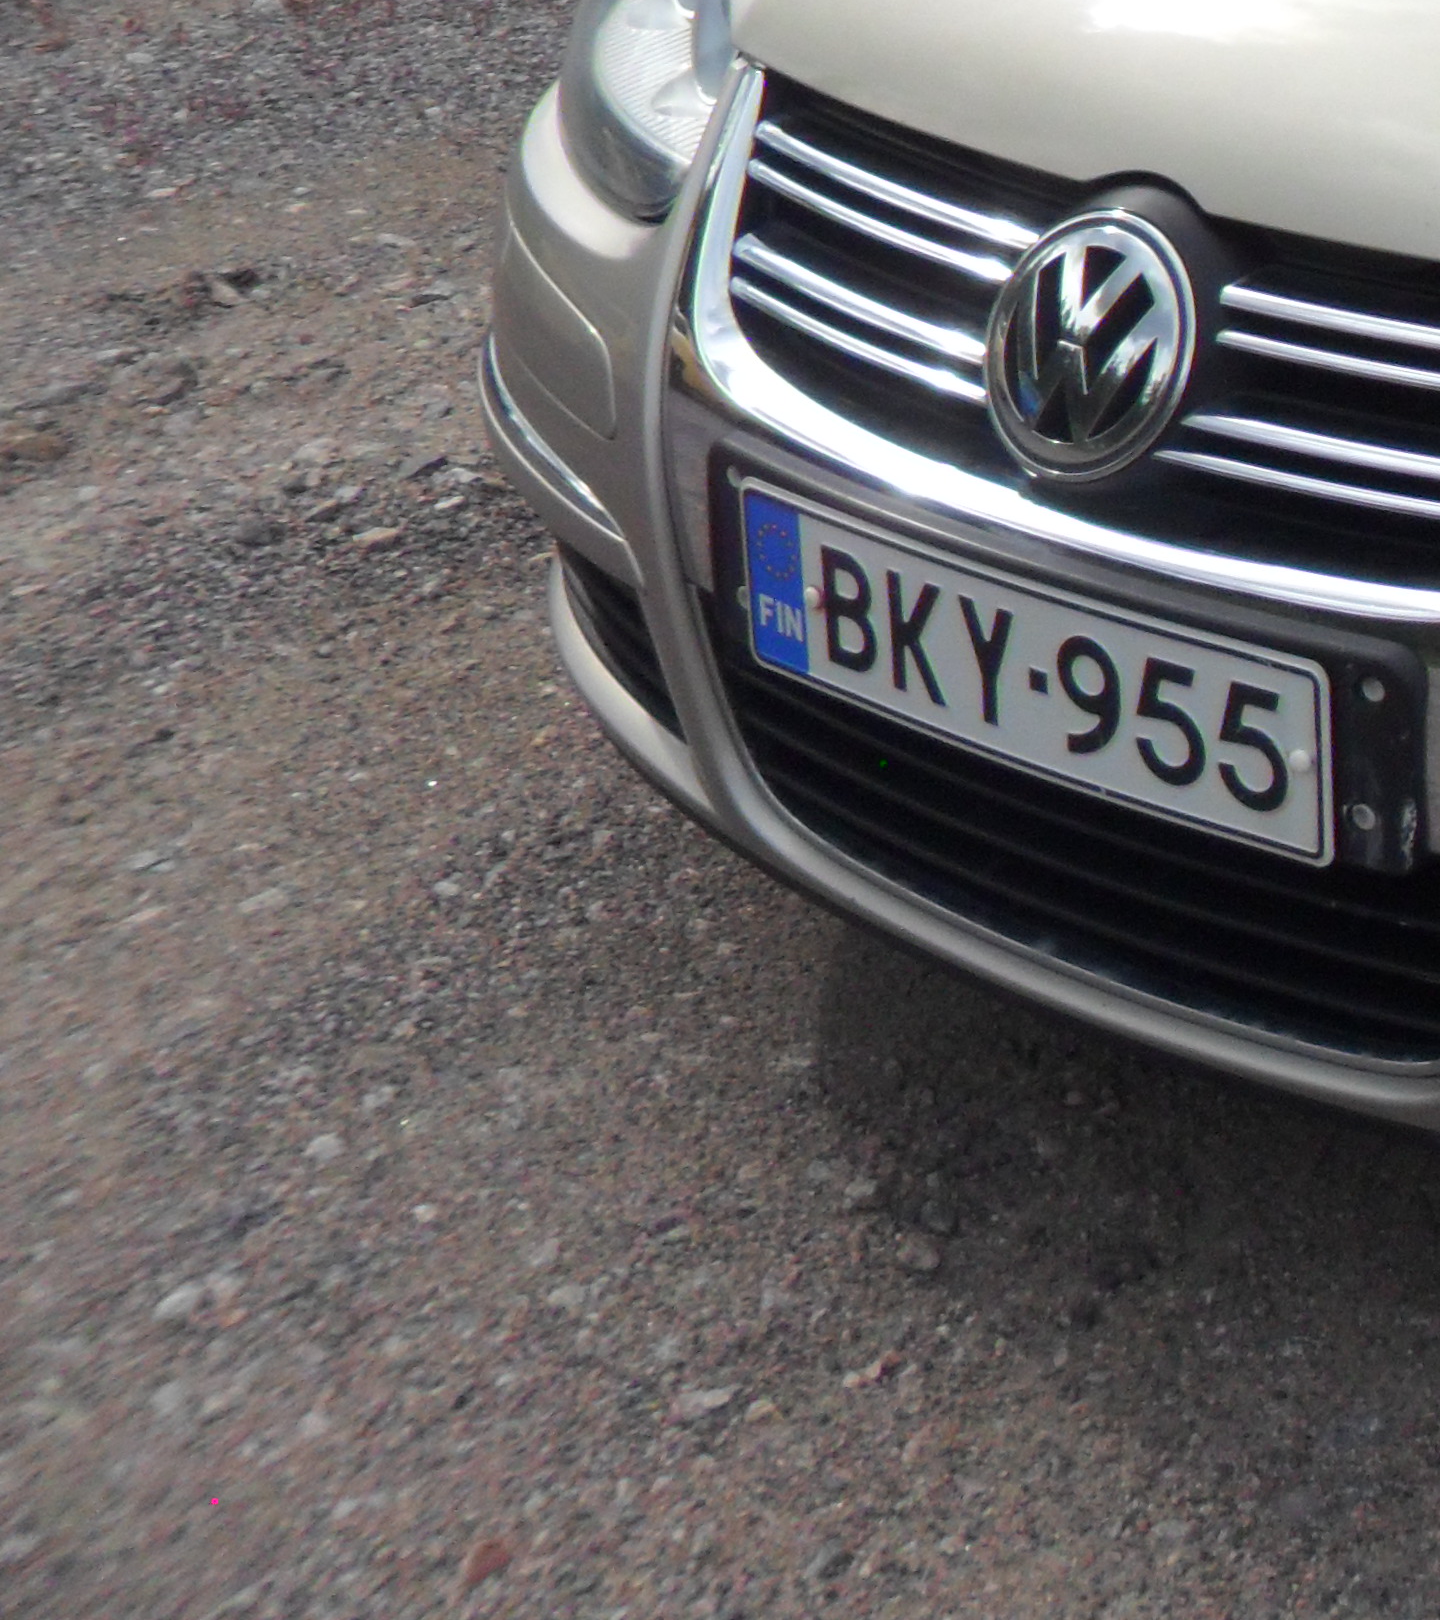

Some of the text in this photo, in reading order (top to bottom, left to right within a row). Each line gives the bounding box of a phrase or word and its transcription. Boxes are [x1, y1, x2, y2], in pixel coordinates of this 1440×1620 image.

[1000, 224, 1182, 462] VW
[758, 593, 803, 642] FIN
[821, 545, 1289, 812] BKY-955
